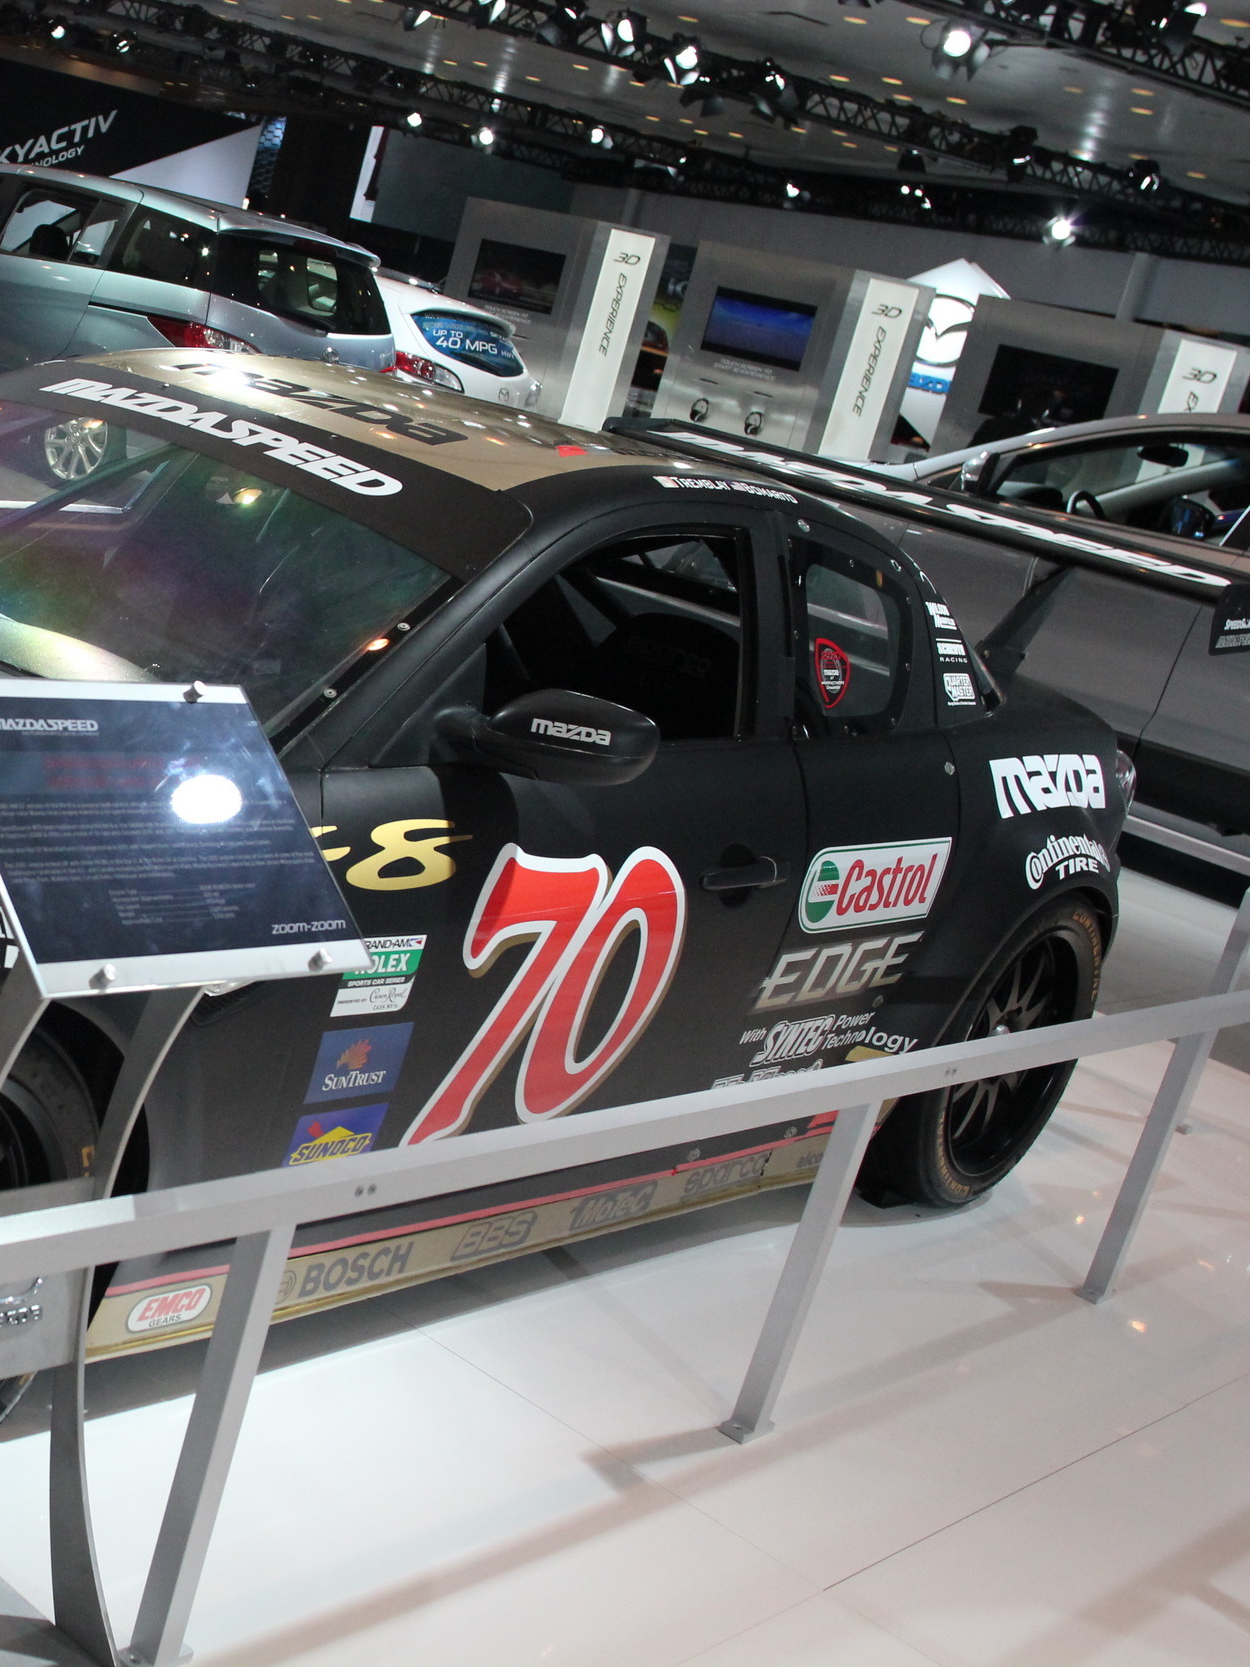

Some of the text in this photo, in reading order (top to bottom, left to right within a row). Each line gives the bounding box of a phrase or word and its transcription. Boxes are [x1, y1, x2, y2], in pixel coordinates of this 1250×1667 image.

[598, 252, 641, 356] 3D EXPERIENCE
[433, 329, 464, 339] UP TO
[436, 337, 461, 348] 40
[465, 339, 498, 355] MPG
[853, 304, 903, 417] 3D EXPERIENCE
[1182, 368, 1217, 384] 3D
[39, 378, 403, 496] MAZDASPEED
[531, 718, 611, 746] mazda
[989, 754, 1106, 819] mazda
[1055, 857, 1099, 880] TIRE
[836, 853, 938, 916] Castrol
[272, 919, 346, 935] zoom-zoom
[366, 939, 410, 950] RAND-AM
[355, 953, 410, 975] OLEX
[754, 930, 925, 1010] EDGE
[347, 979, 371, 988] SPORTS
[385, 977, 405, 985] SERIES
[398, 842, 687, 1149] 70
[833, 1011, 875, 1031] Power
[739, 1027, 768, 1045] With
[751, 1014, 835, 1067] SYNTEC
[822, 1026, 918, 1054] Technology
[290, 1134, 370, 1164] SUNOCO
[797, 1152, 824, 1169] alco
[684, 1149, 769, 1194] sparco
[451, 1211, 538, 1262] BBS
[298, 1242, 414, 1299] BOSCH
[137, 1287, 206, 1322] EMCO
[148, 1313, 181, 1328] GEARS
